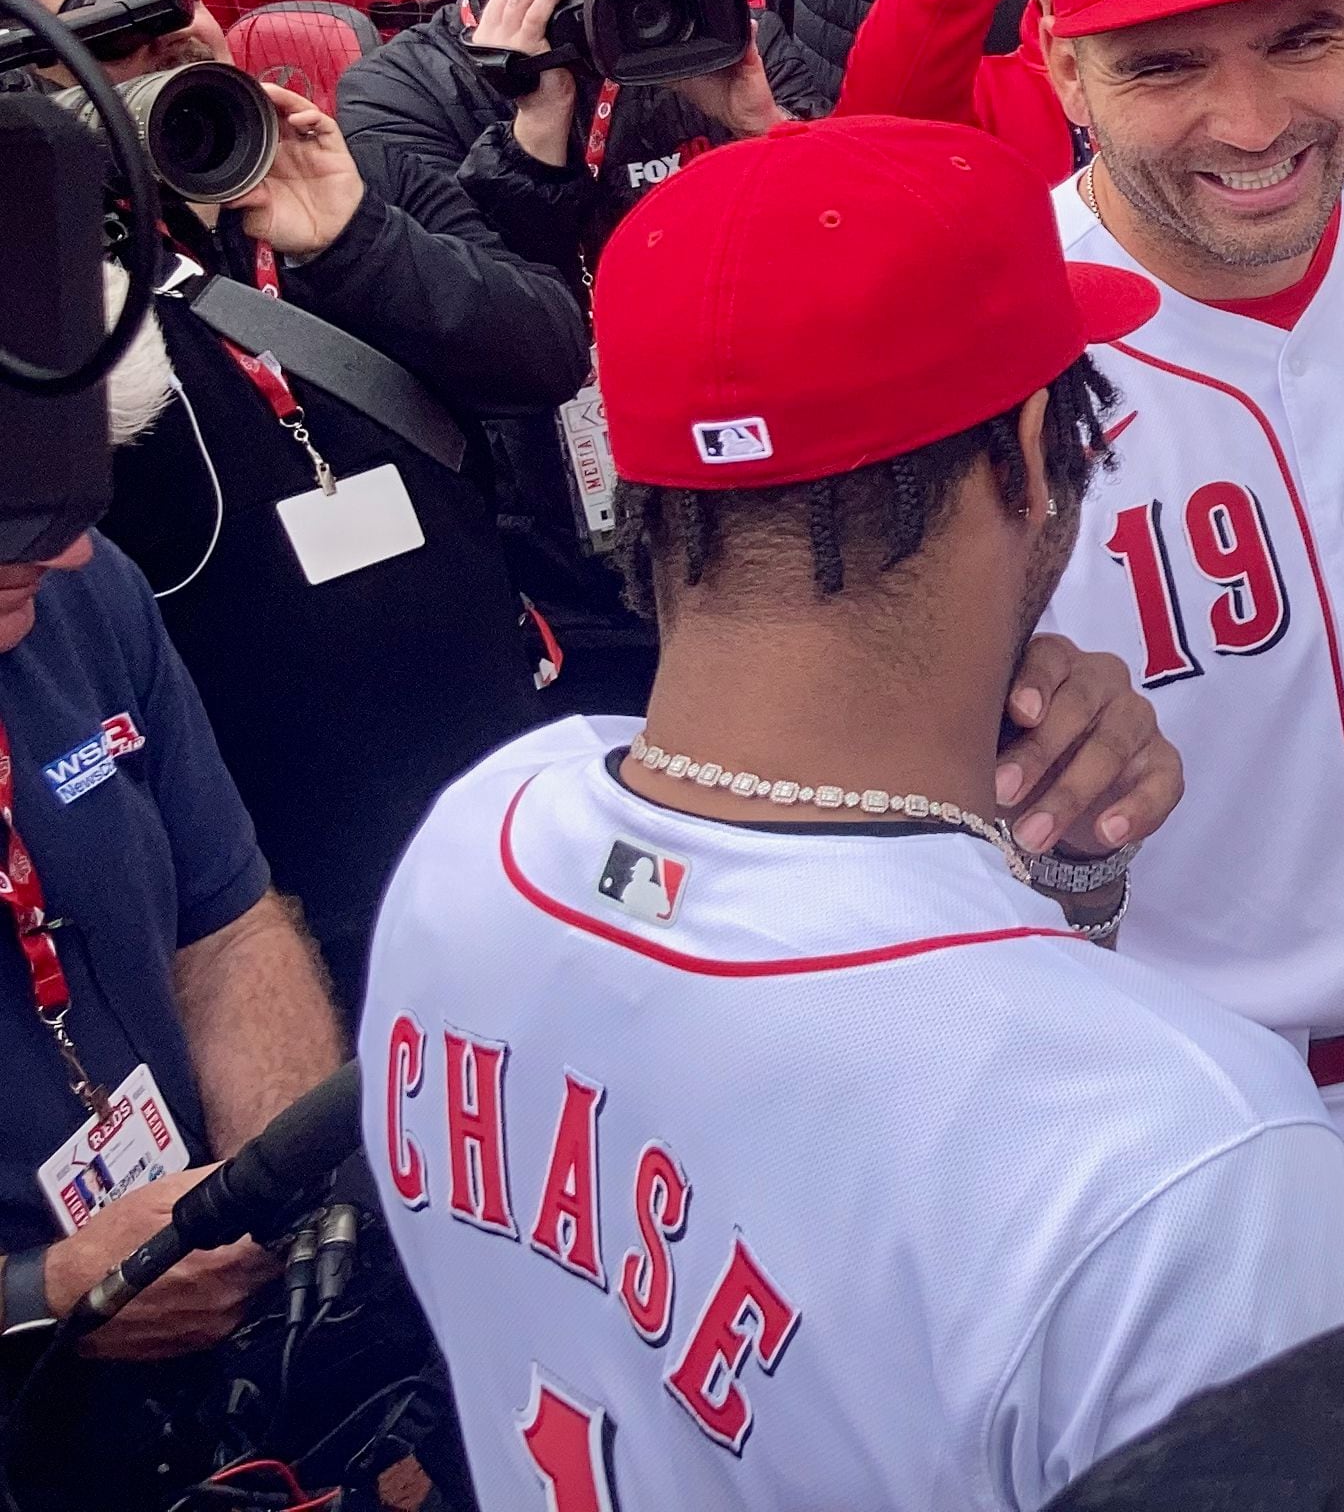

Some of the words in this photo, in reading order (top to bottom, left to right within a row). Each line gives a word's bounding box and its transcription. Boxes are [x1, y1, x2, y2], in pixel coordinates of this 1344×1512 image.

[577, 438, 602, 490] MEDIA
[1103, 481, 1287, 686] 19
[143, 1102, 168, 1150] MEDIA
[386, 1009, 803, 1458] CHASE
